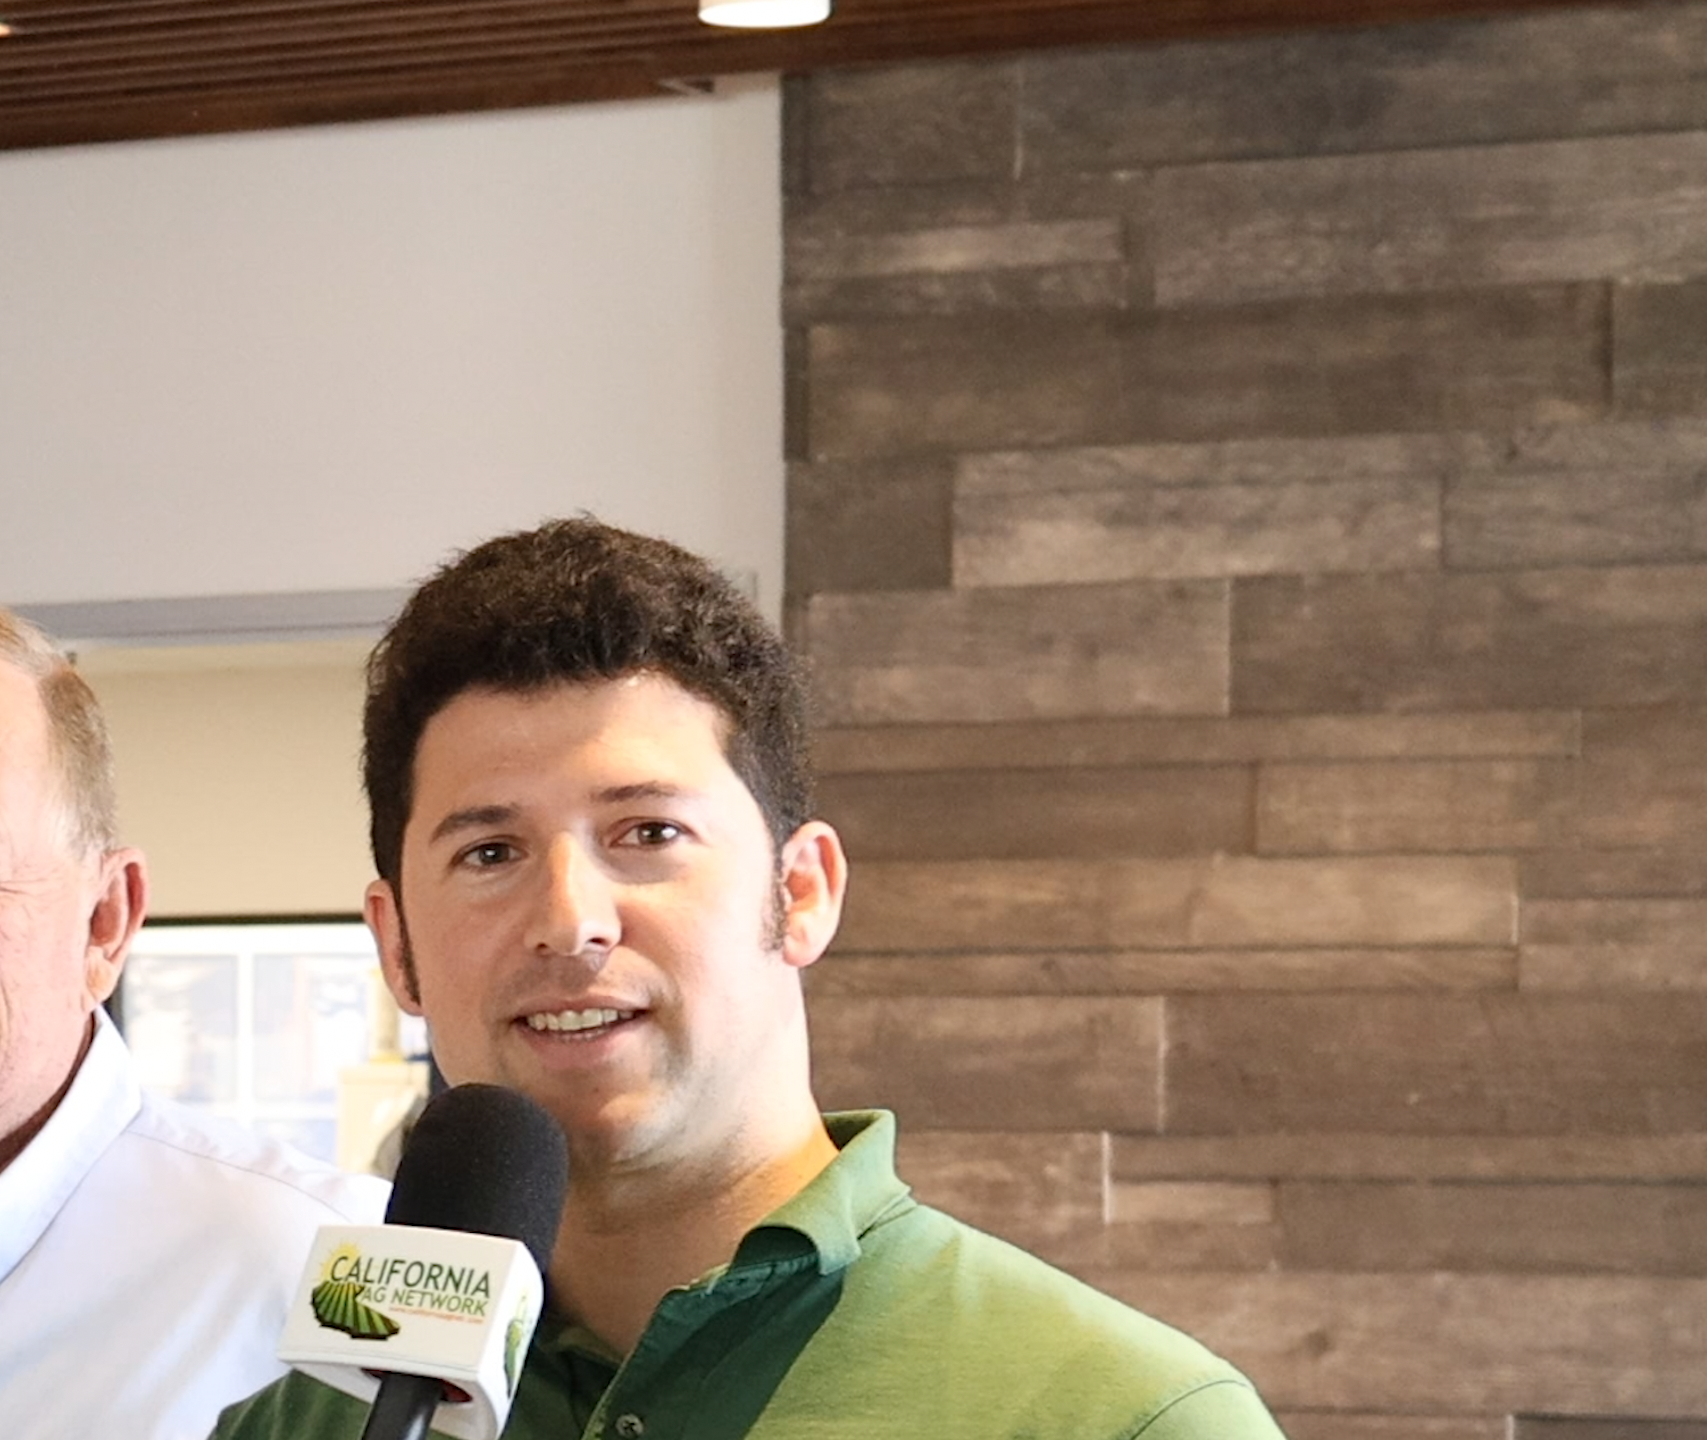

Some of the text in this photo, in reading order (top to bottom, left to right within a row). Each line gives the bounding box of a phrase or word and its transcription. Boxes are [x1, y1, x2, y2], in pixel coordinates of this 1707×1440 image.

[329, 1255, 491, 1299] CALIFORNIA
[362, 1286, 387, 1304] AG
[391, 1289, 489, 1317] NETWORK
